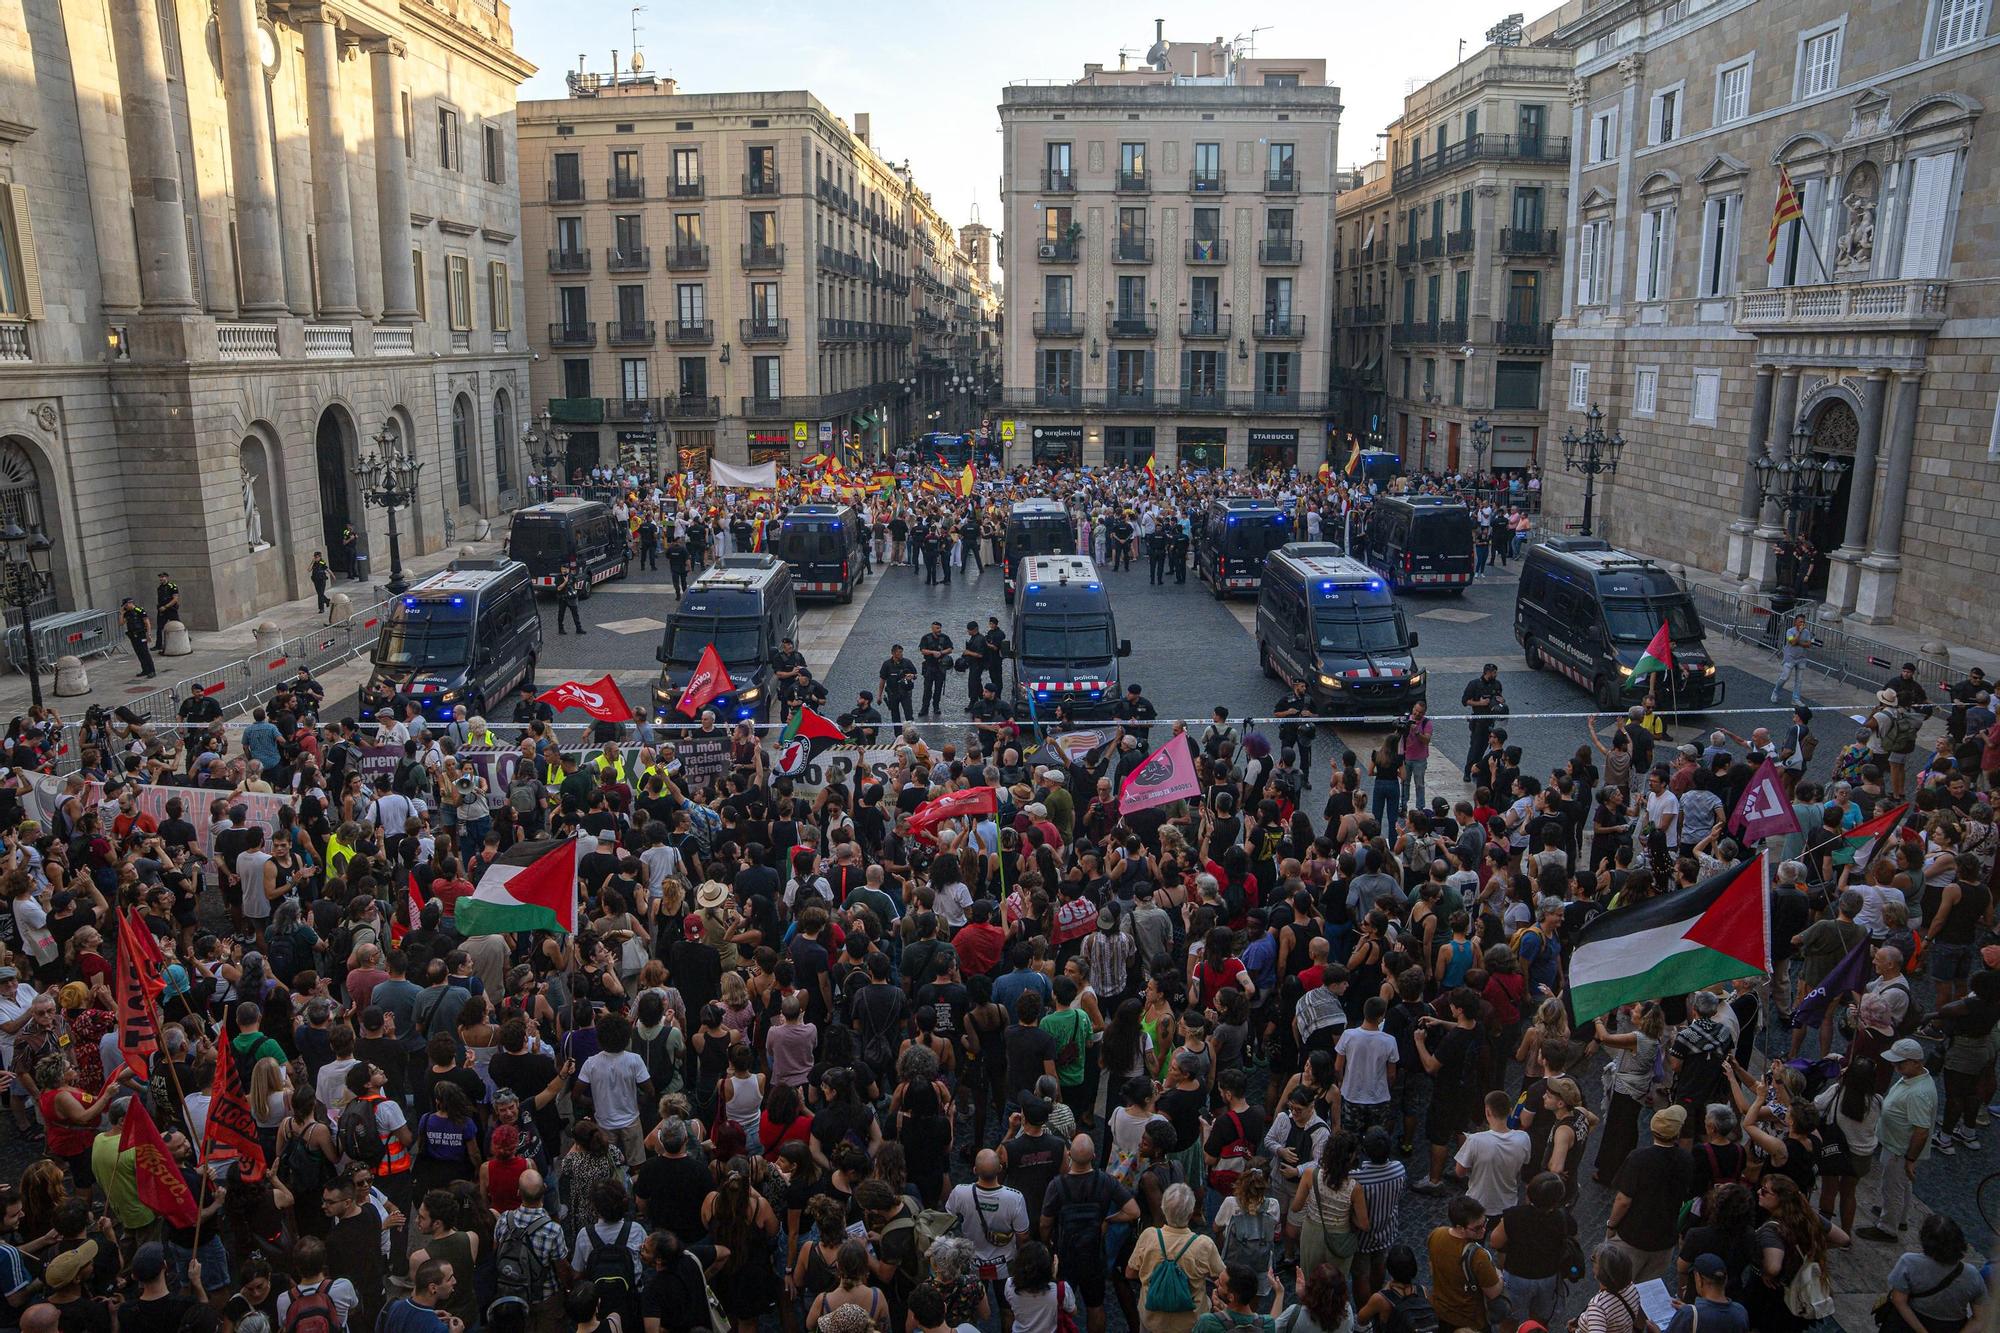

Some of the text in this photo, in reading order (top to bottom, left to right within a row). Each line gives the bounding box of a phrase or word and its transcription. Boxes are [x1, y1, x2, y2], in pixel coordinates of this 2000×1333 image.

[1044, 429, 1070, 438] sunglass
[729, 674, 748, 682] licia
[678, 744, 694, 754] un
[694, 741, 722, 752] món
[685, 751, 731, 765] racisme
